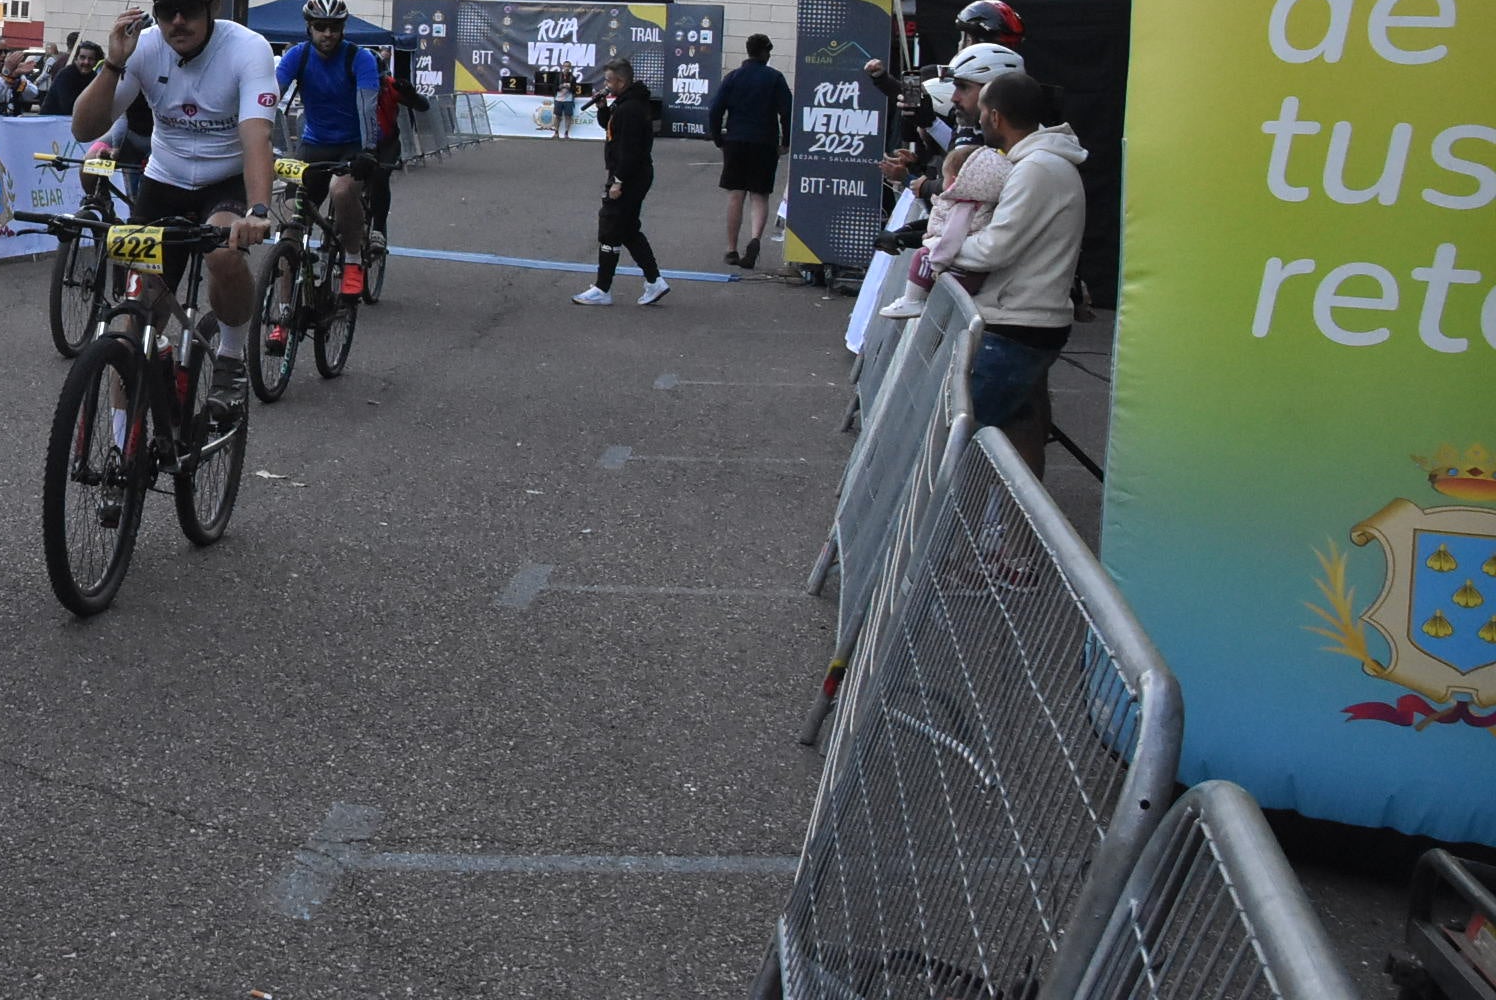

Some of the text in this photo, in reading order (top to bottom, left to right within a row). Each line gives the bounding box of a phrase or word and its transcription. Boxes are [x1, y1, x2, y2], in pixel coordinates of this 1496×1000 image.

[537, 17, 579, 43] RUTA
[630, 27, 662, 43] TRAIL
[472, 51, 493, 64] BTT
[528, 42, 596, 67] VETONA
[677, 62, 700, 78] RUTA
[509, 78, 516, 88] 2
[542, 74, 548, 83] 1
[672, 78, 709, 94] VETONA
[576, 85, 582, 95] 3
[814, 81, 860, 109] RUTA
[675, 93, 702, 105] 2025
[803, 107, 879, 136] VETONA
[808, 133, 865, 156] 2025
[278, 162, 301, 175] 235
[829, 156, 880, 165] SALAMANCA
[112, 236, 157, 259] 222
[1252, 243, 1496, 354] ret
